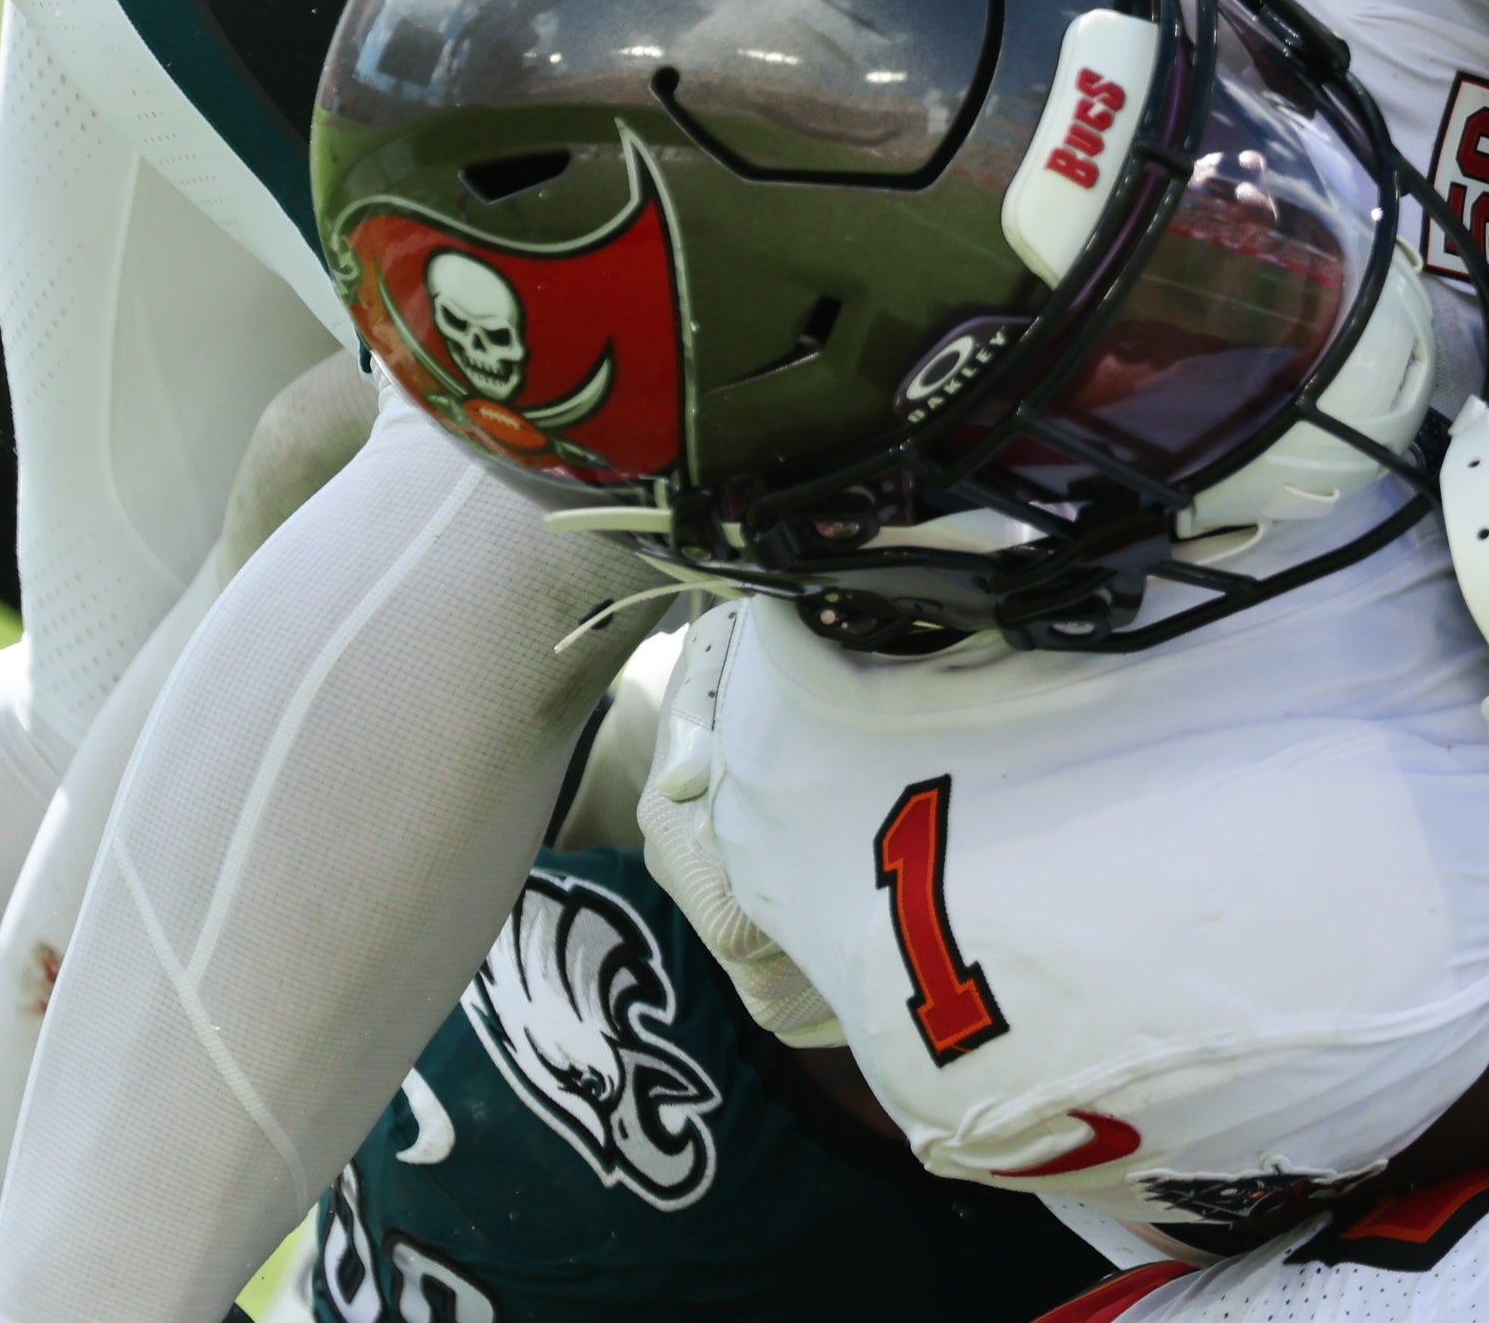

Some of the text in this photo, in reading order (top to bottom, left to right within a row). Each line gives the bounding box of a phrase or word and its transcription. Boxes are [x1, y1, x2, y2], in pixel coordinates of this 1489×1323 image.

[1043, 67, 1127, 190] BUCS
[907, 325, 1007, 423] OAKLEY
[874, 773, 1009, 1067] 1
